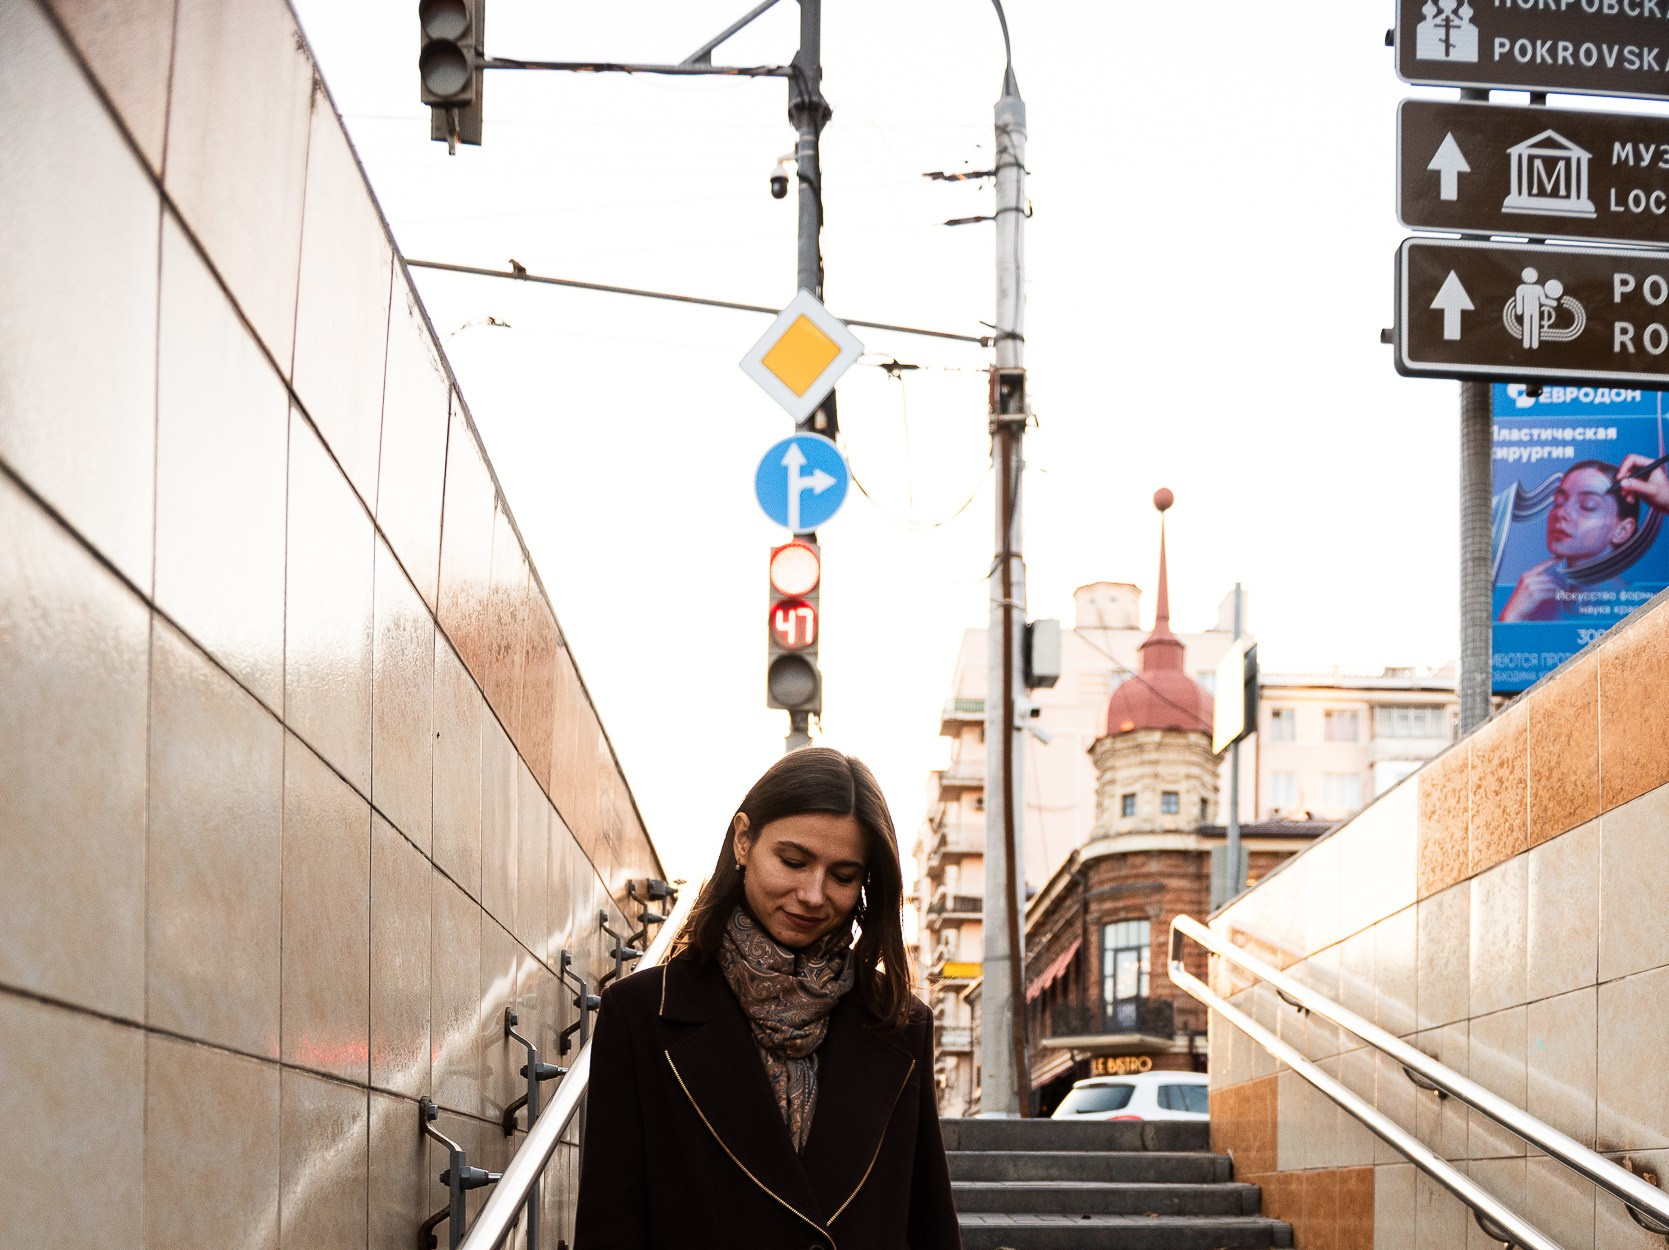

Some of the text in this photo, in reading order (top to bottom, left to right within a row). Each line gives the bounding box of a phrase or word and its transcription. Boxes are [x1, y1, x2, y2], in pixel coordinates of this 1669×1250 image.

[1494, 37, 1669, 71] POKROVSK
[1610, 187, 1667, 215] LOC
[1613, 272, 1669, 306] РО
[1613, 321, 1669, 355] RO
[775, 607, 814, 646] 47
[1106, 1056, 1153, 1073] BISTRO
